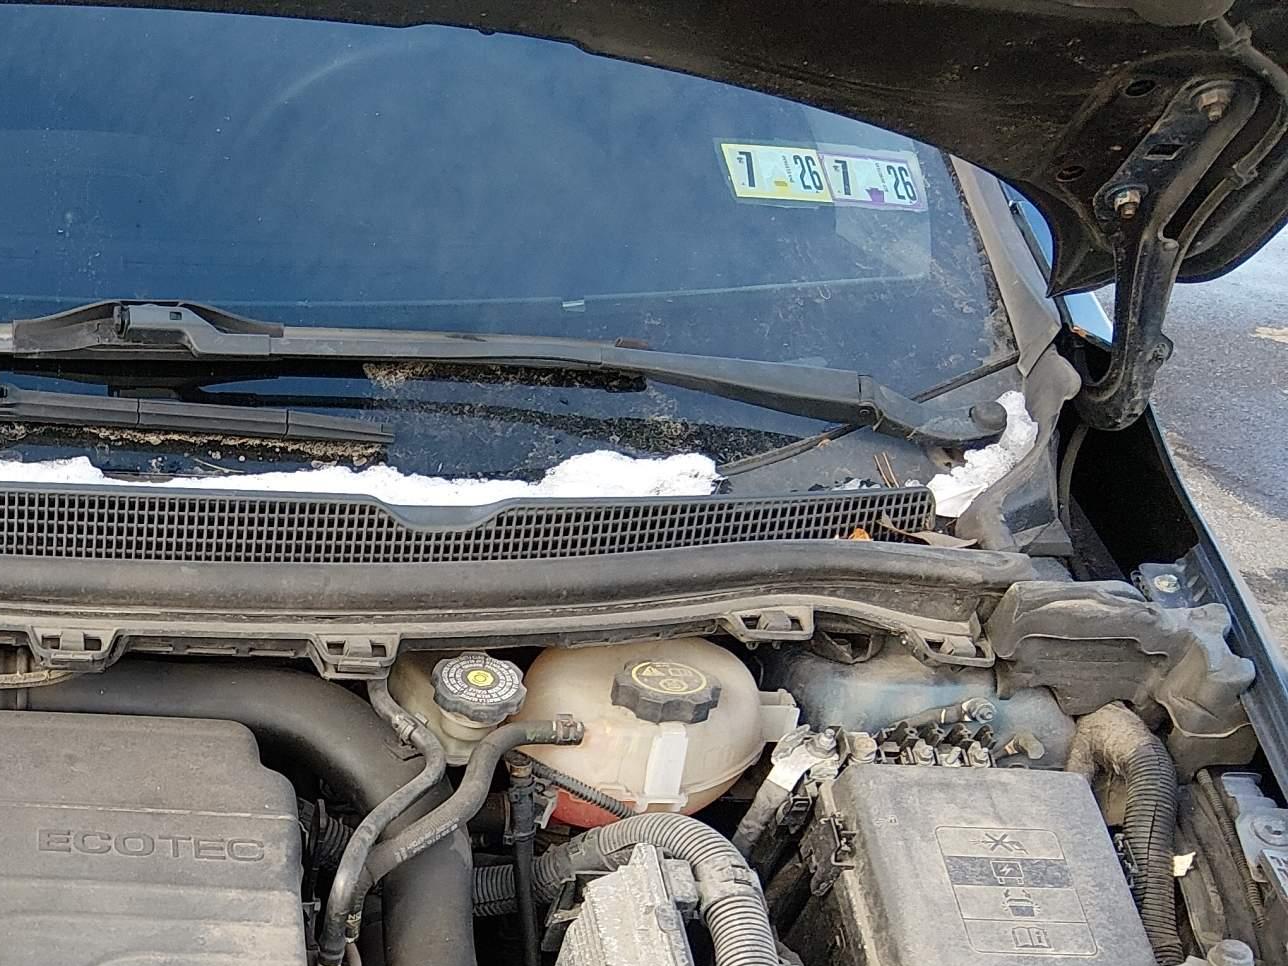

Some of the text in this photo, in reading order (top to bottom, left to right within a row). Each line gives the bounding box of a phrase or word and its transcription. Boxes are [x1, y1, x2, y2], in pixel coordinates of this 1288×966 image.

[738, 151, 756, 188] 7
[793, 154, 824, 191] 26
[834, 159, 852, 196] 7
[886, 164, 917, 201] 26
[38, 829, 264, 862] ECOTEC
